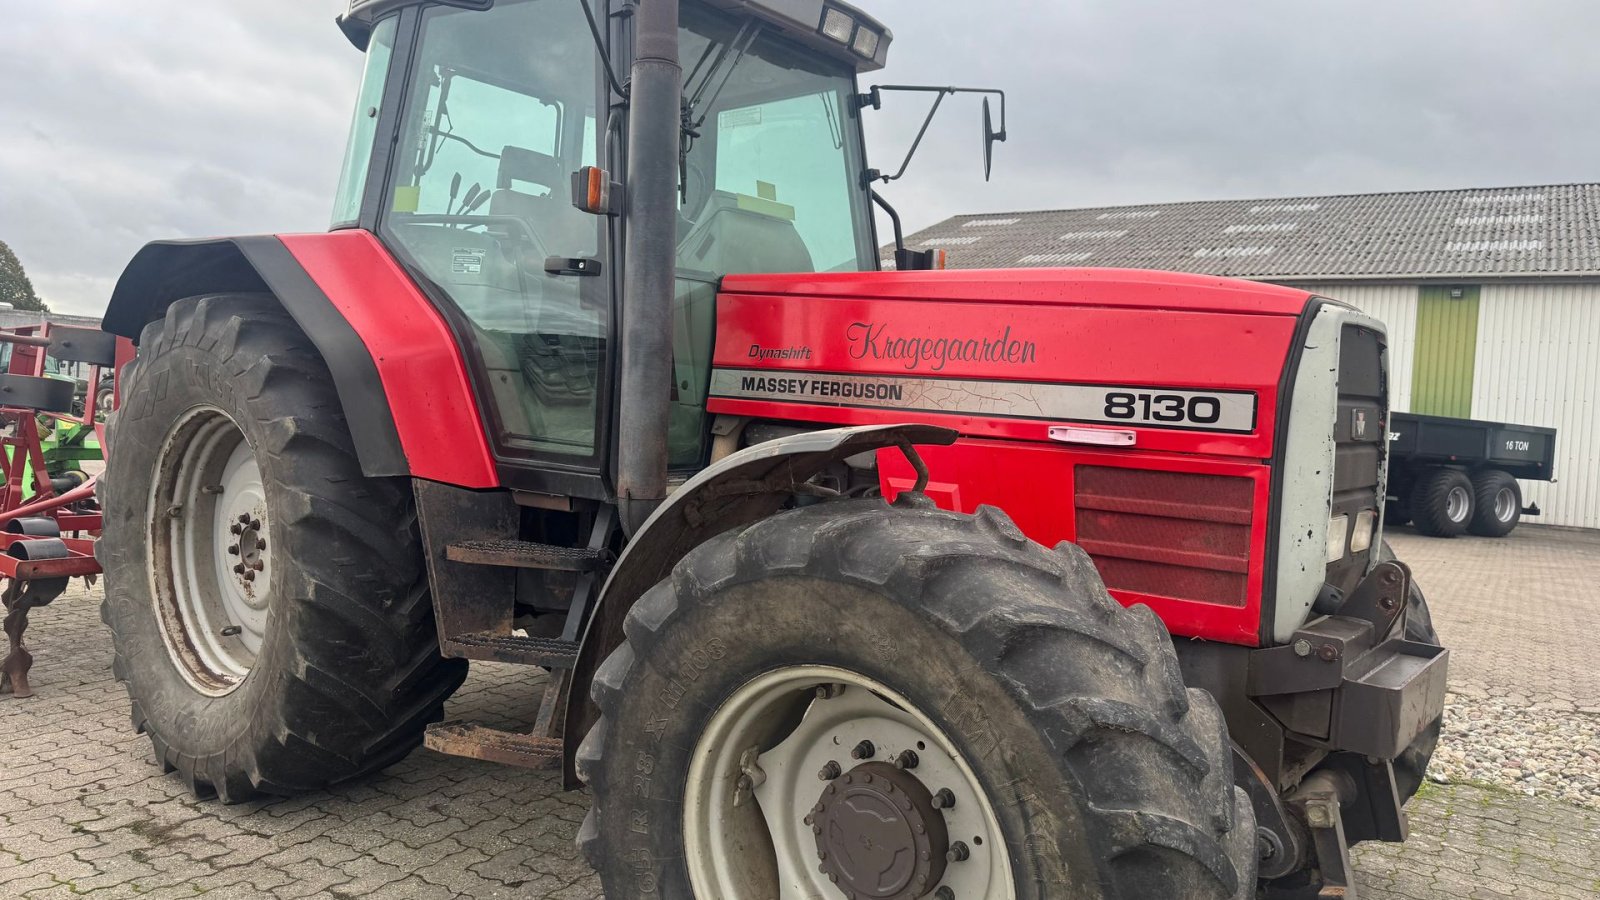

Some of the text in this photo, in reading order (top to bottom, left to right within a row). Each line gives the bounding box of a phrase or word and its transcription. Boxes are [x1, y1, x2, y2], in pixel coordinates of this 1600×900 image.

[748, 344, 812, 361] Dynashift
[846, 322, 1036, 371] Kragegaarden
[741, 376, 903, 401] MASSEY FERGUSON
[1104, 392, 1221, 424] 8130
[1506, 440, 1530, 451] 16 TON
[632, 750, 656, 799] 28
